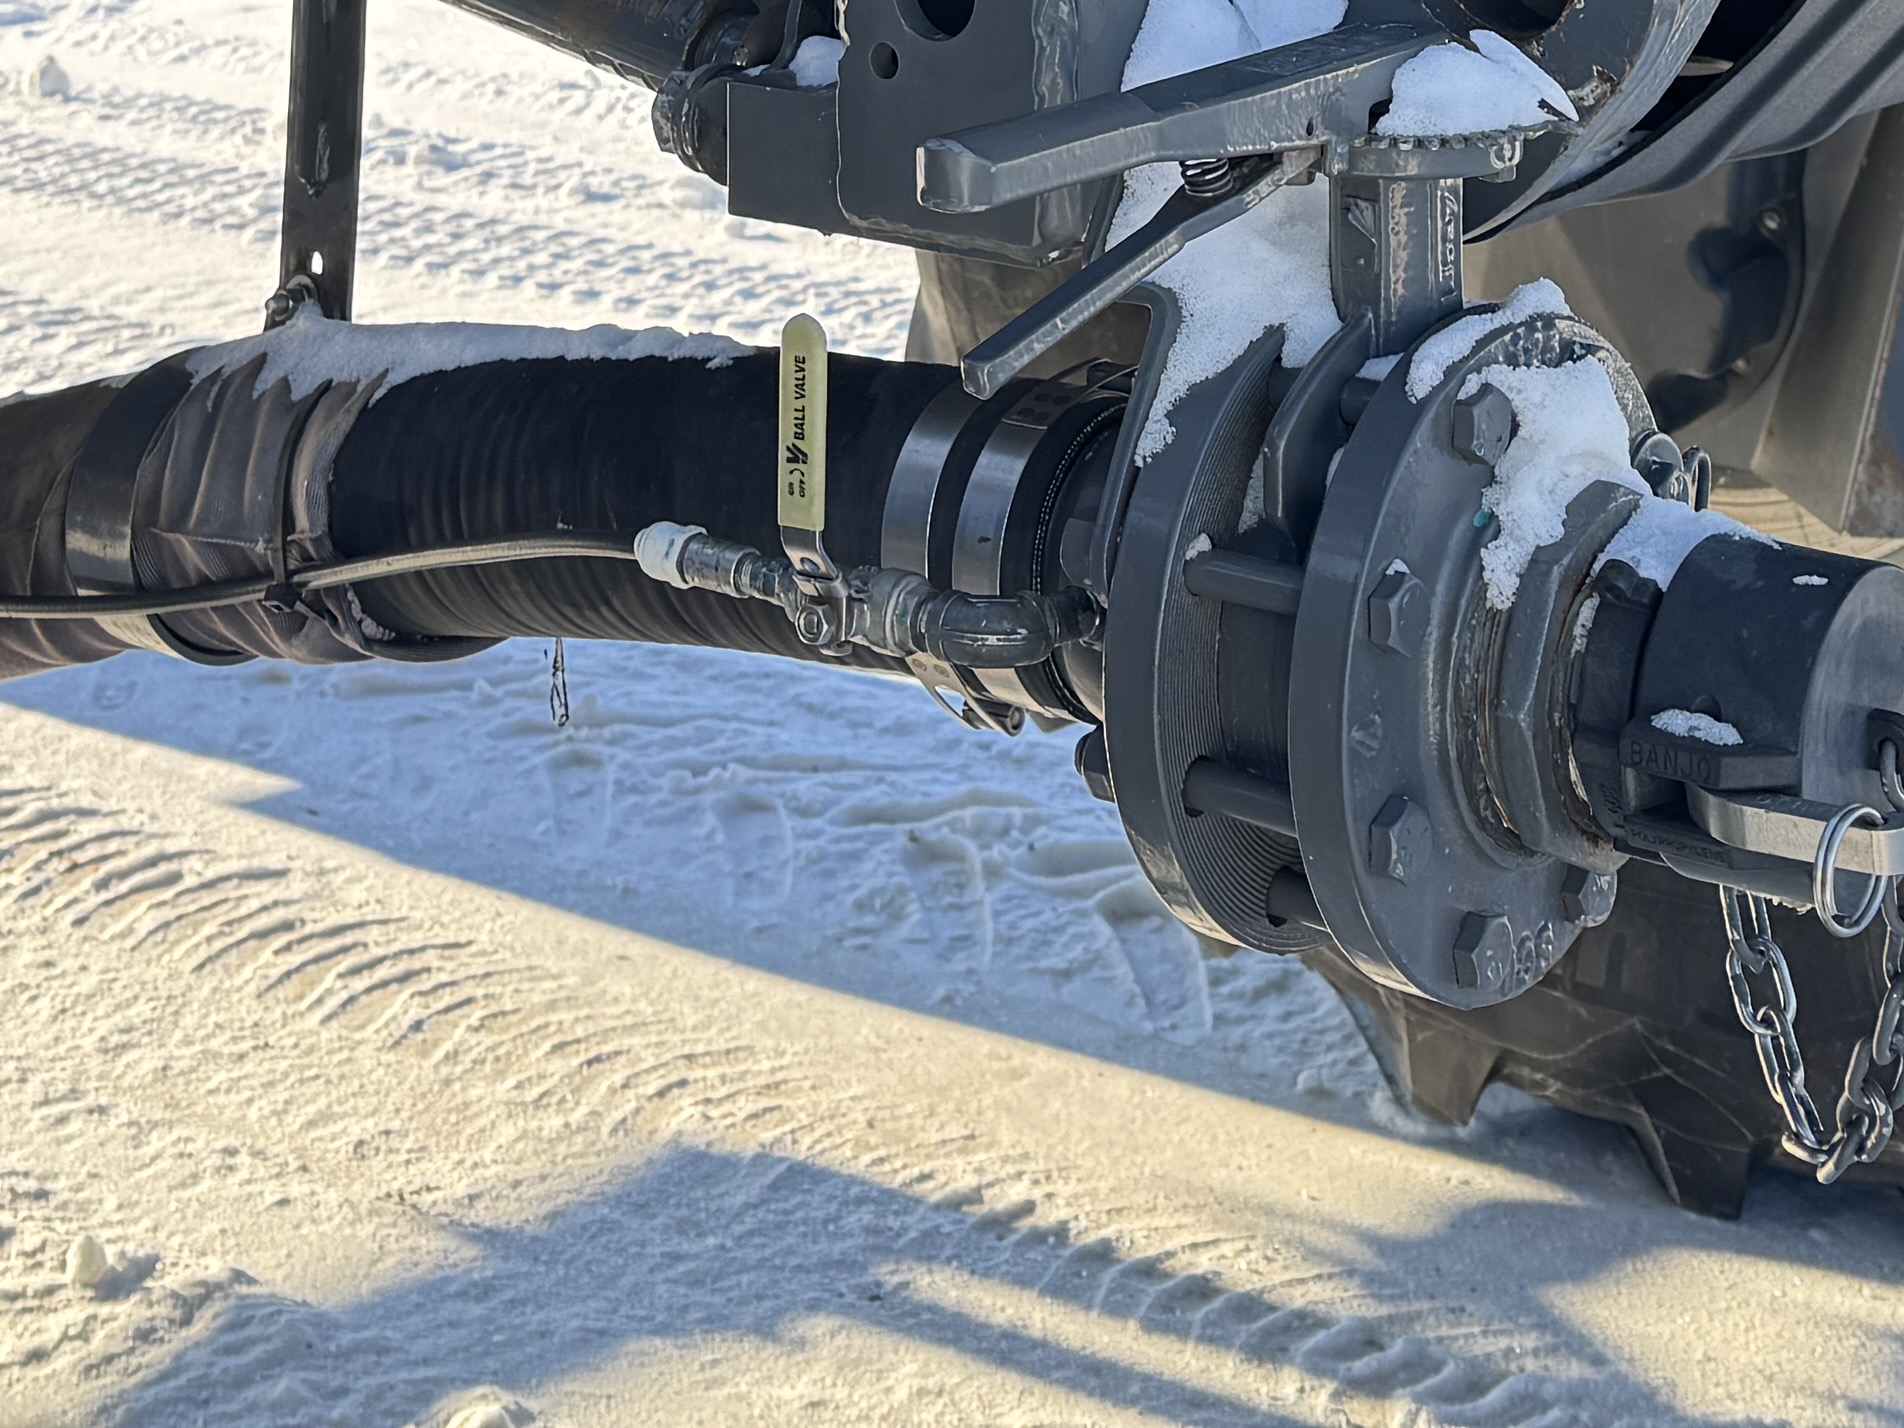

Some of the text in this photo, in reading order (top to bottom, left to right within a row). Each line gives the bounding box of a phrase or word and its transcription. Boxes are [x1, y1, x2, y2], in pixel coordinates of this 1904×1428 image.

[793, 354, 807, 401] VALVE
[793, 404, 805, 441] BALL
[1630, 740, 1713, 782] BANJO
